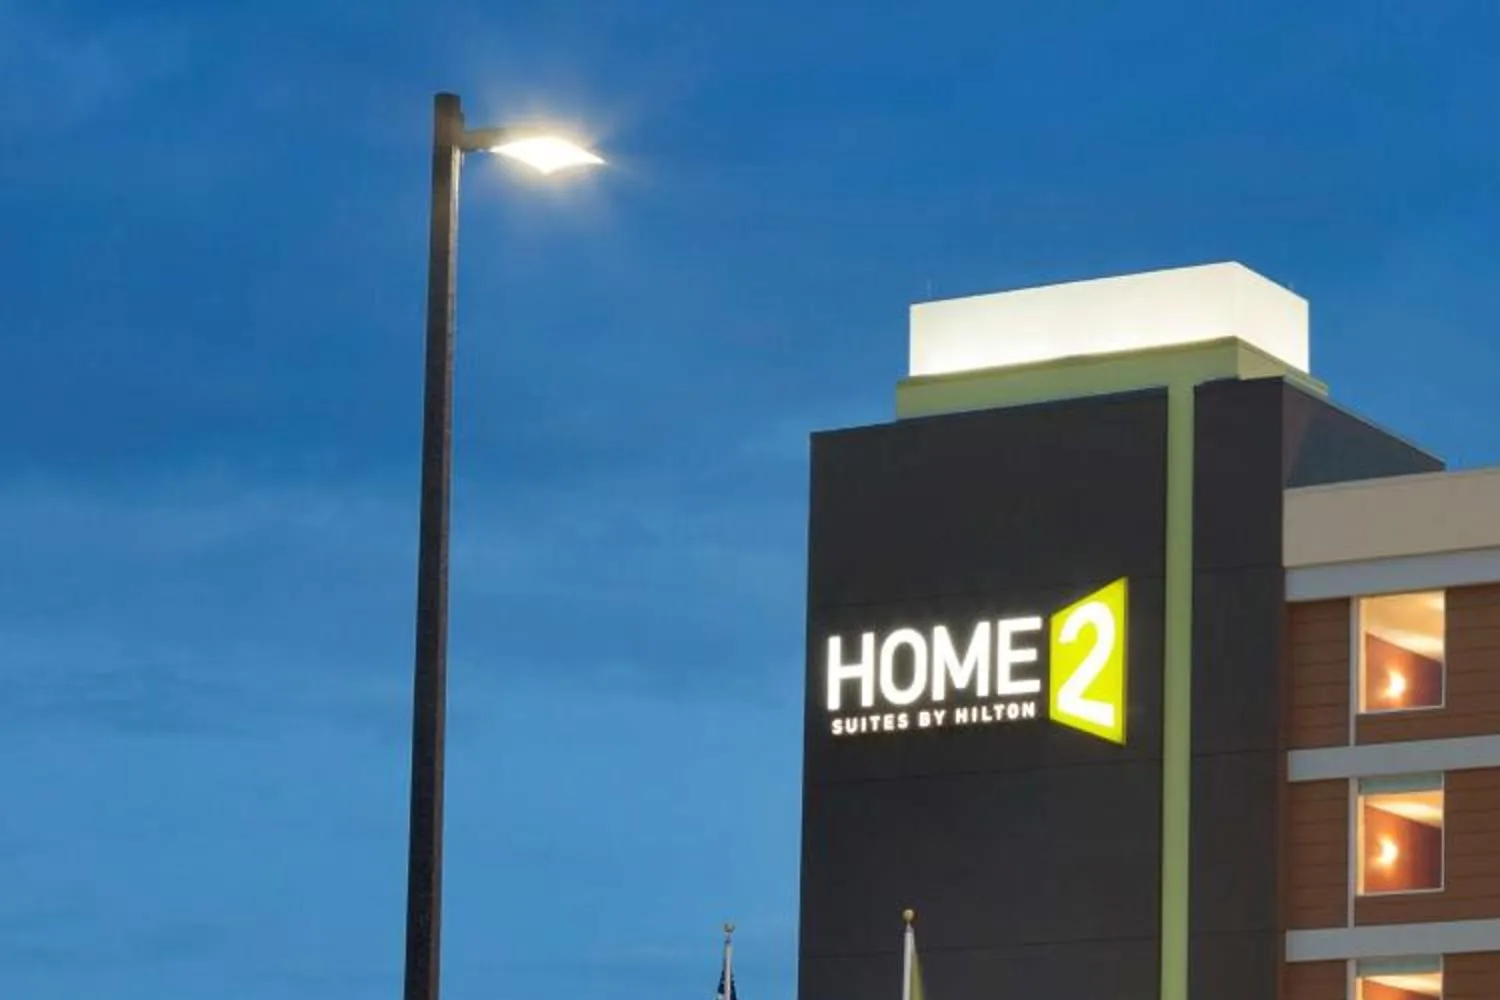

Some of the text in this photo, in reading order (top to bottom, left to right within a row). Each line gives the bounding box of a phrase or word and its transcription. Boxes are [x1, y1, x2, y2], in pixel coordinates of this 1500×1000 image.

[831, 701, 1036, 735] SUITES BY HILTON
